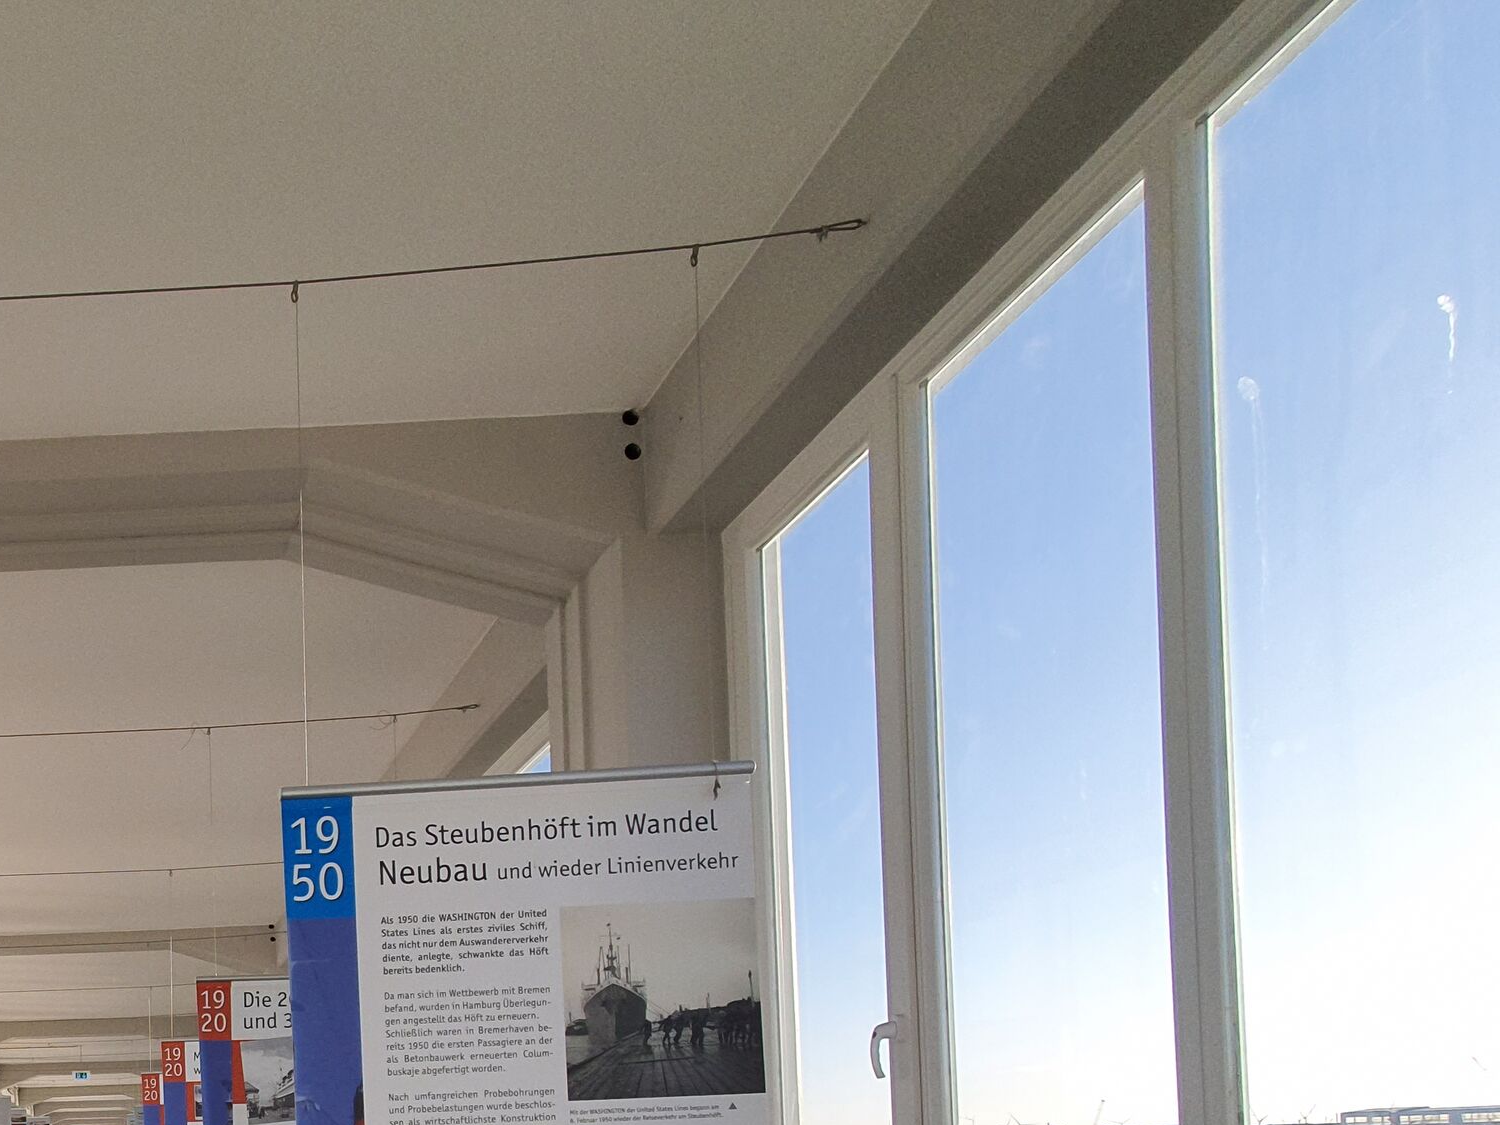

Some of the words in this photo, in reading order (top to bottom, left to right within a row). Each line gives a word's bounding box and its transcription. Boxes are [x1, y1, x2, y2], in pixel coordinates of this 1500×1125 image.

[289, 814, 341, 857] 19
[375, 826, 416, 848] Das
[425, 816, 581, 845] Steubenhöft
[587, 815, 617, 837] im
[625, 809, 721, 834] Wandel
[379, 857, 487, 884] Neubau
[497, 861, 532, 880] und
[538, 858, 601, 877] wieder
[607, 852, 741, 874] Linienverkehr
[291, 860, 345, 903] 50
[380, 916, 393, 924] Als
[397, 914, 418, 924] 1950
[421, 913, 435, 923] die
[438, 911, 496, 922] WASHINGTON
[499, 910, 513, 919] der
[517, 908, 547, 918] United
[382, 965, 412, 975] bereits
[414, 963, 465, 974] bedenklich.
[201, 990, 226, 1010] 19
[243, 990, 272, 1008] Die
[277, 991, 292, 1008] 2
[201, 1012, 227, 1033] 20
[243, 1011, 278, 1030] und
[385, 1026, 433, 1038] Schließlich
[436, 1028, 462, 1036] waren
[465, 1026, 474, 1034] in
[477, 1024, 534, 1034] Bremerhaven
[537, 1023, 552, 1033] be-
[164, 1047, 181, 1061] 19
[164, 1063, 183, 1077] 20
